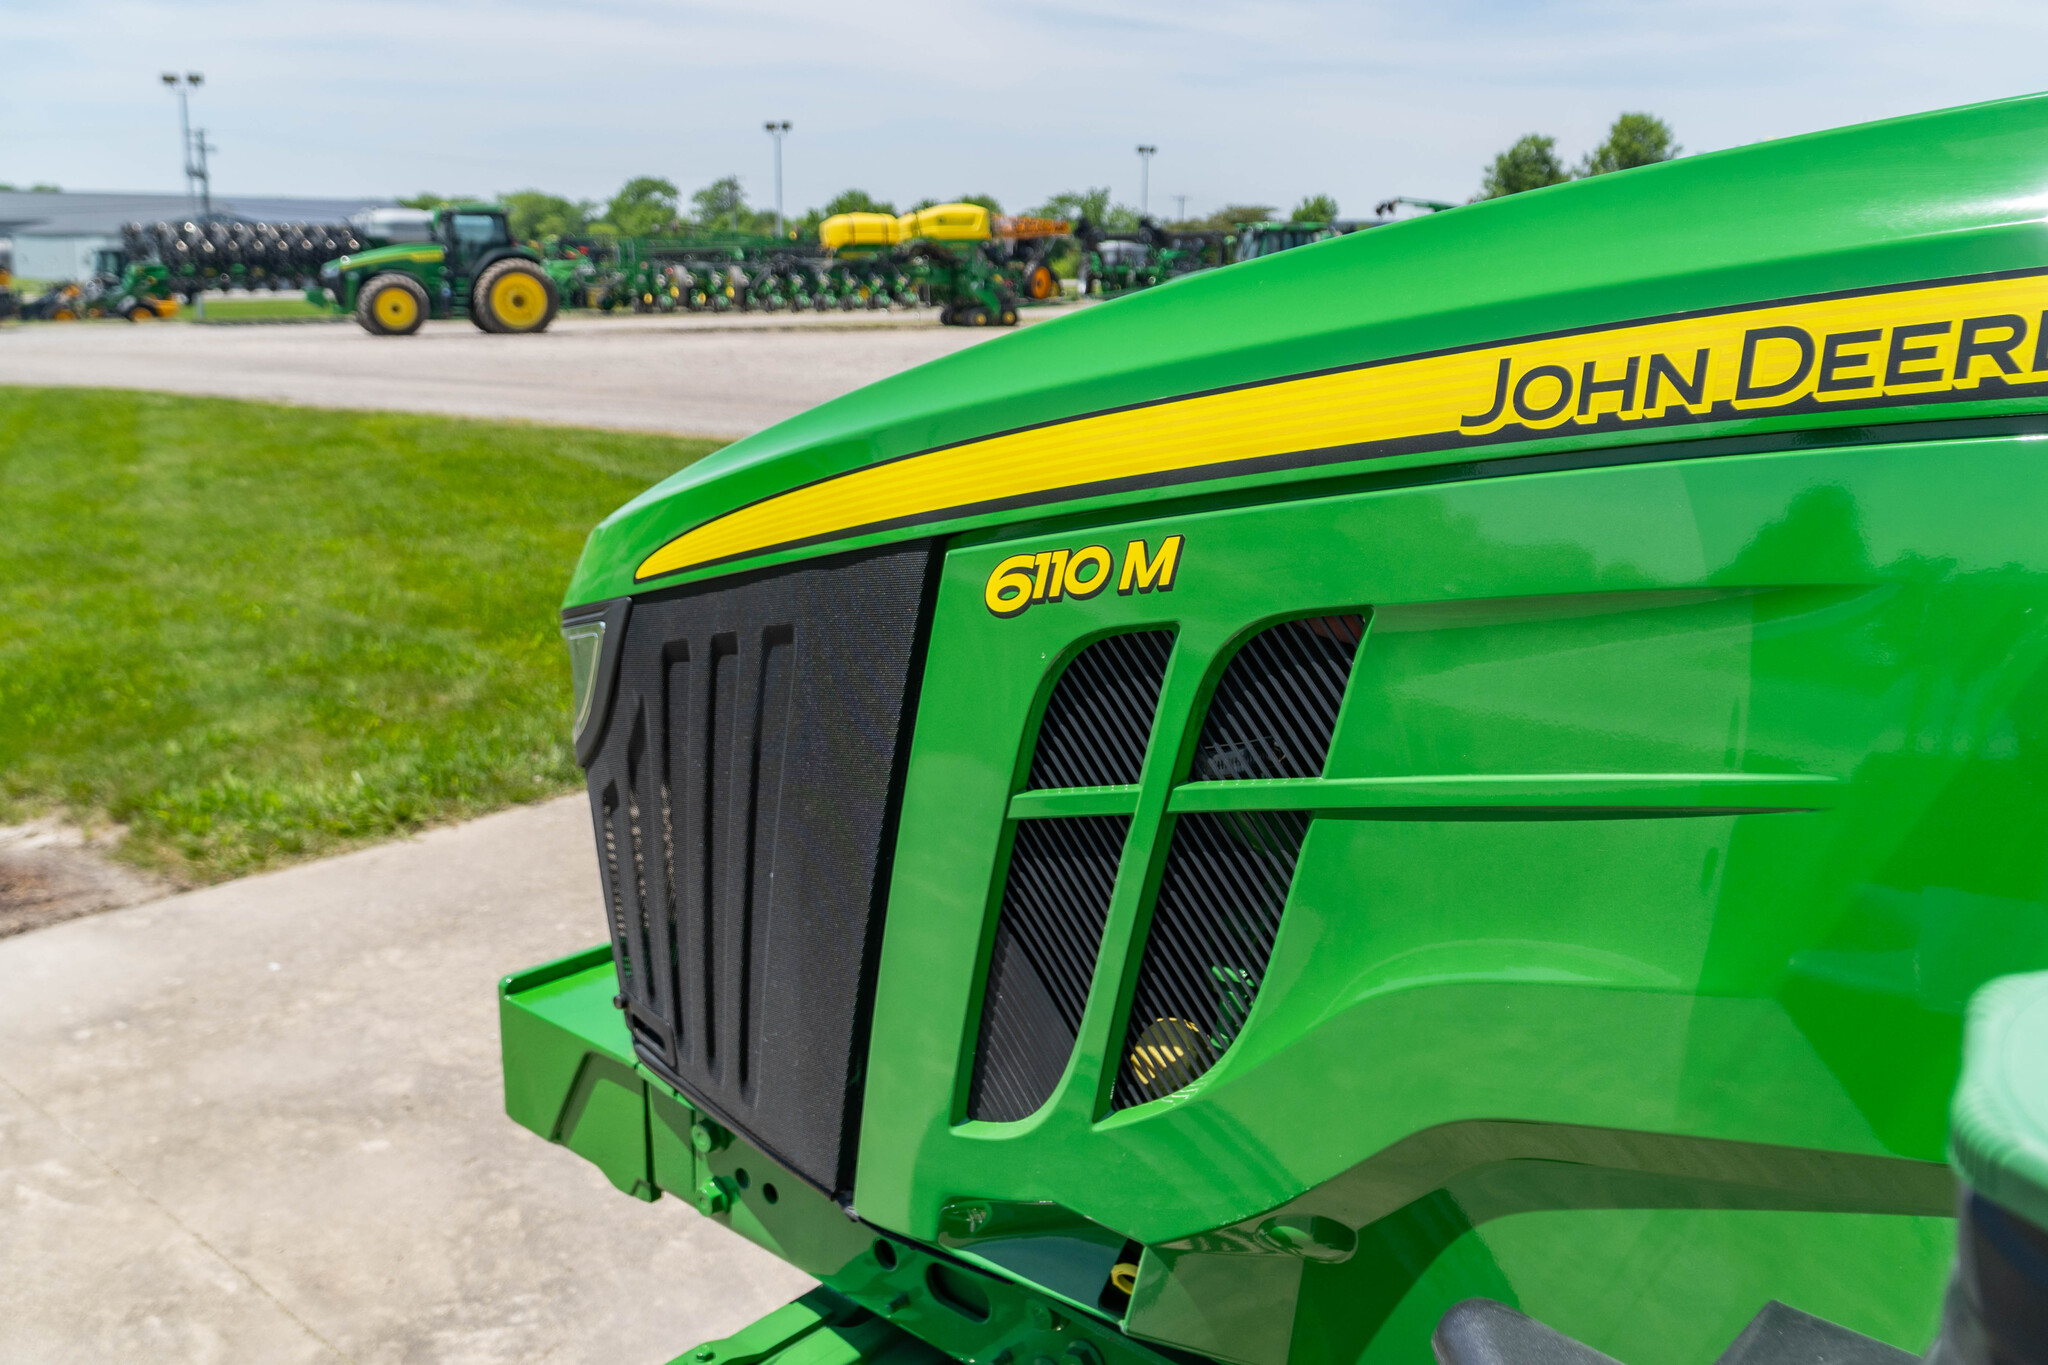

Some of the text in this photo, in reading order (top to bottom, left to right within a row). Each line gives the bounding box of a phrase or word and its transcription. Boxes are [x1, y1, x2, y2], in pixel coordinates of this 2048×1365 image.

[1459, 348, 1711, 431] JOHN
[985, 534, 1185, 618] 6110 M
